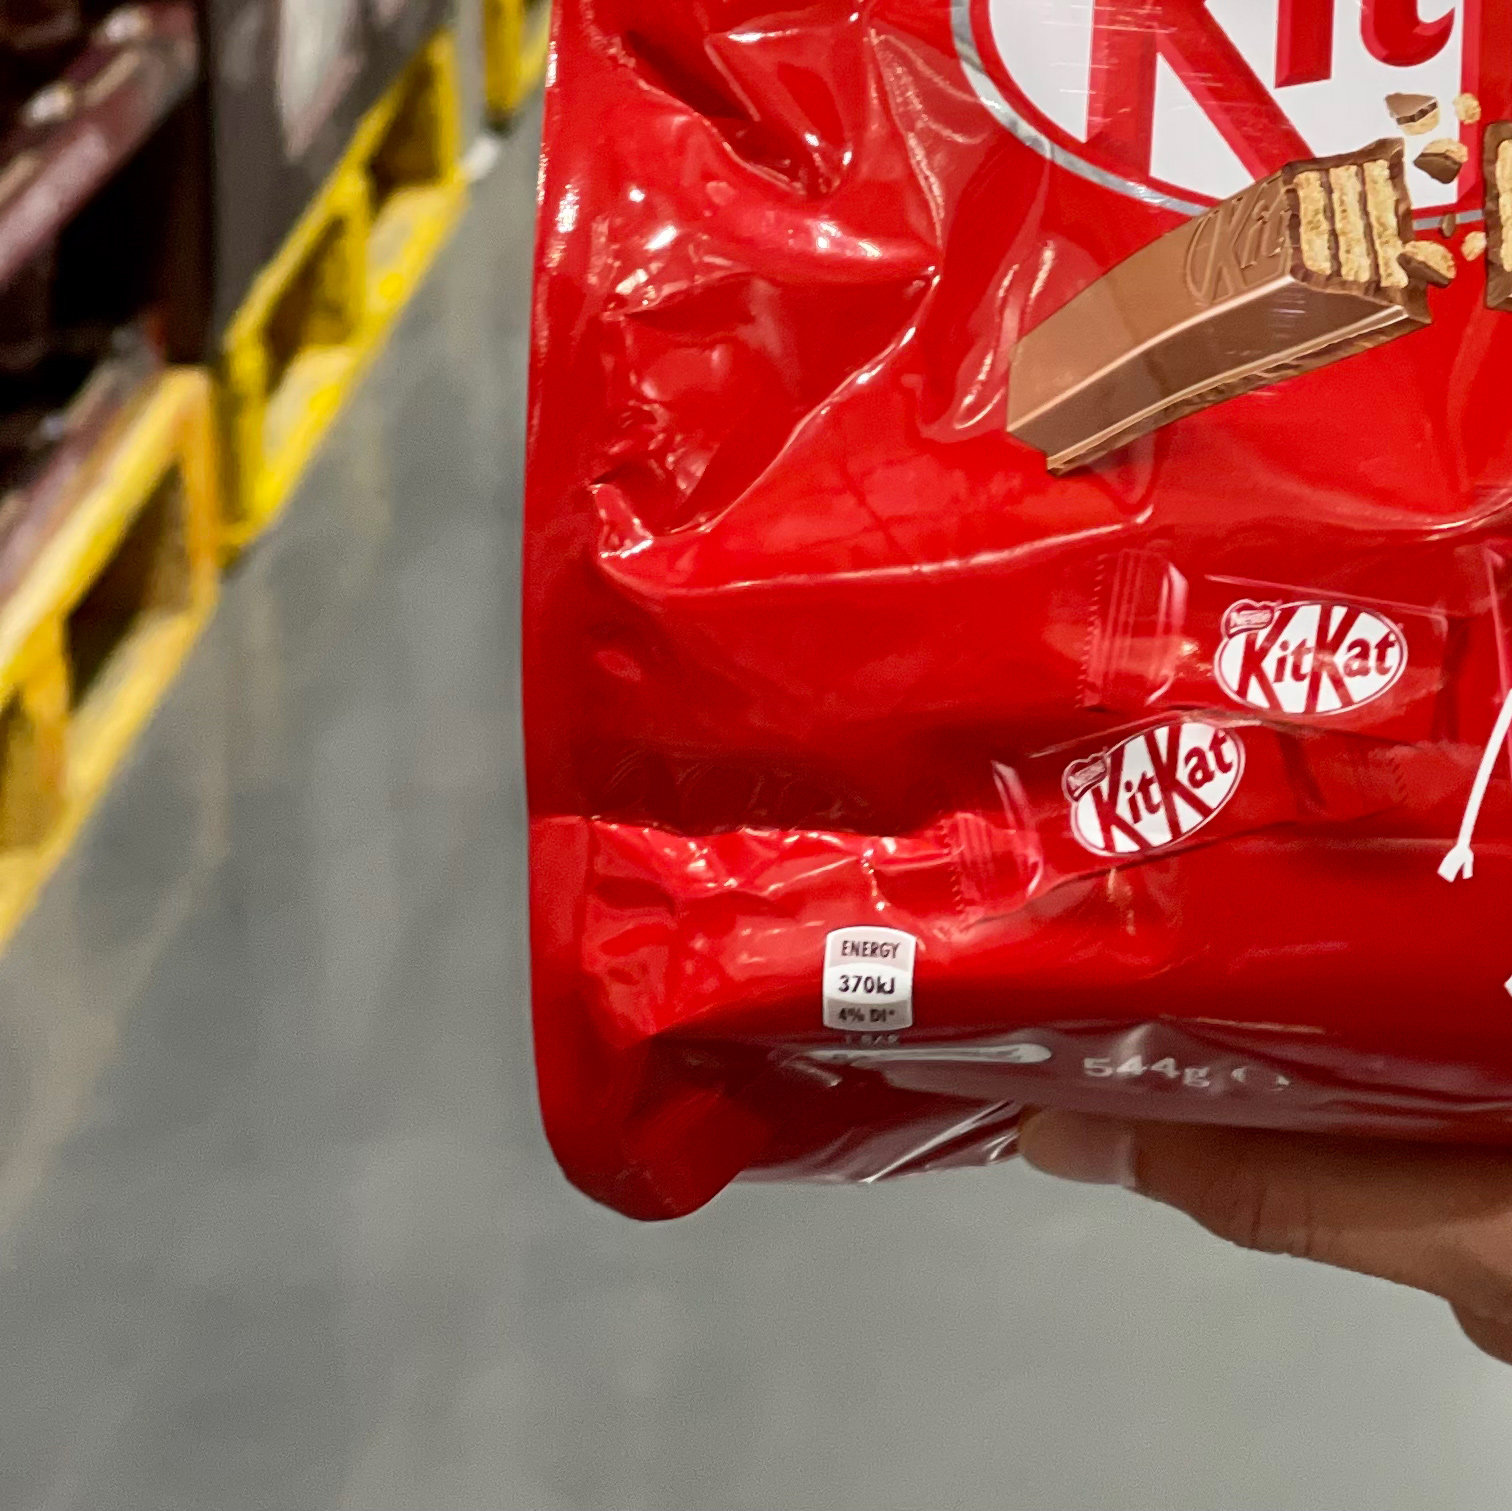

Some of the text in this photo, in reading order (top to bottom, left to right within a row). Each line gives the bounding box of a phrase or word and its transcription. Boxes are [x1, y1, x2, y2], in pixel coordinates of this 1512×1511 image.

[1236, 604, 1397, 713] KitKat
[1091, 725, 1233, 852] KitKat
[841, 940, 901, 959] ENERGY
[838, 974, 896, 994] 370kJ
